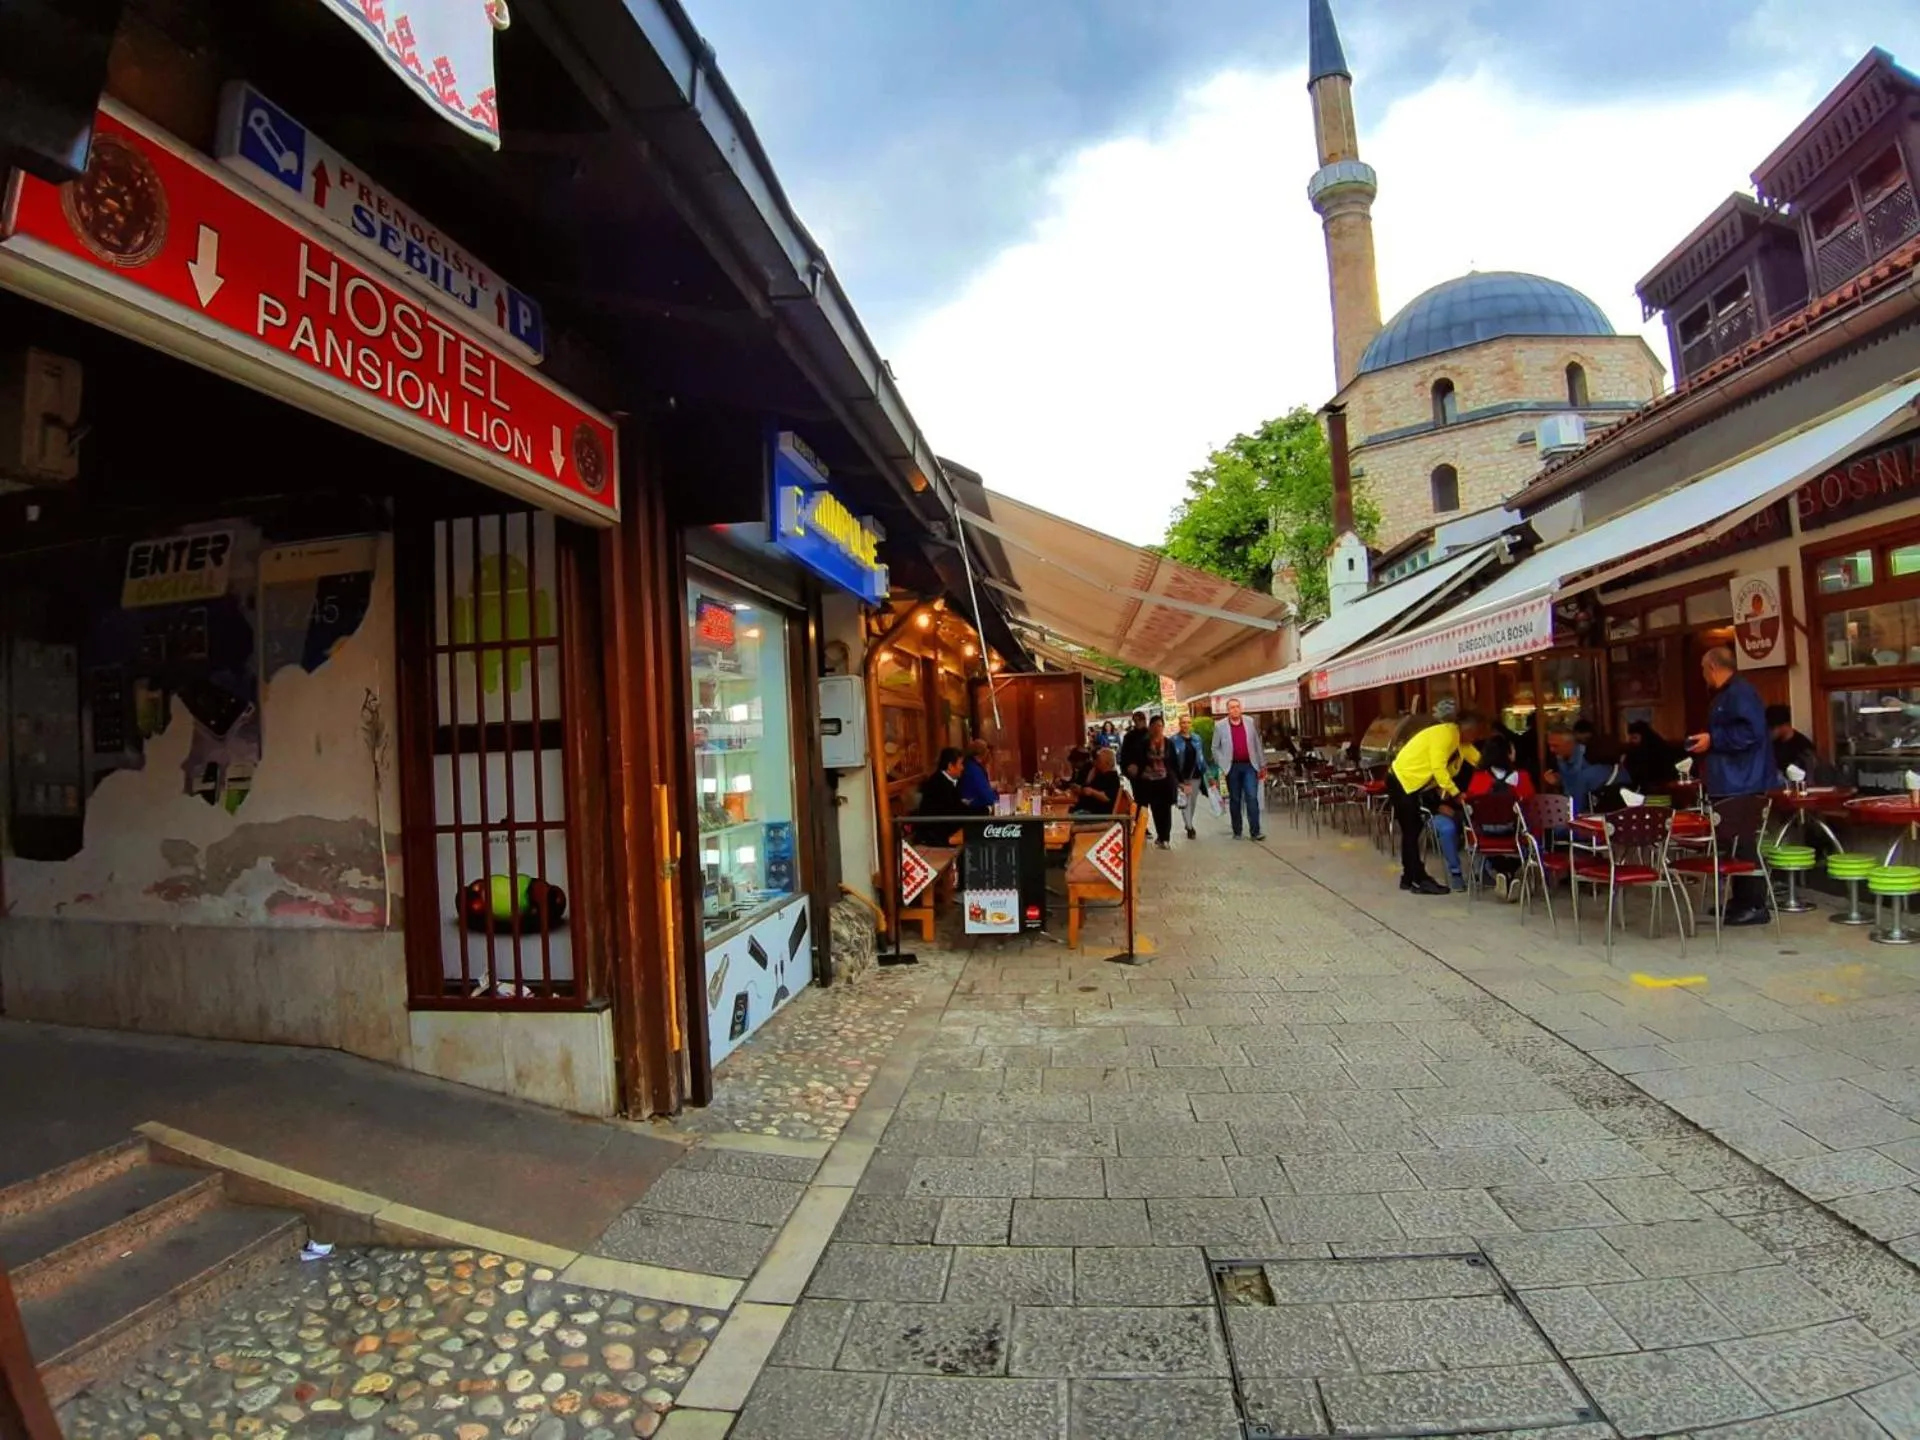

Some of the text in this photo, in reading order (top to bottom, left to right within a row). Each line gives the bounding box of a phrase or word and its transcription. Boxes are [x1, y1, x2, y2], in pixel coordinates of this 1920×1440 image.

[340, 168, 489, 291] PRENOČIŠTE
[352, 204, 478, 309] SEBILJ
[298, 242, 511, 412] HOSTEL
[518, 301, 533, 336] P
[257, 293, 532, 465] PANSION LION
[129, 533, 230, 579] ENTER
[1507, 621, 1534, 641] BOSNA
